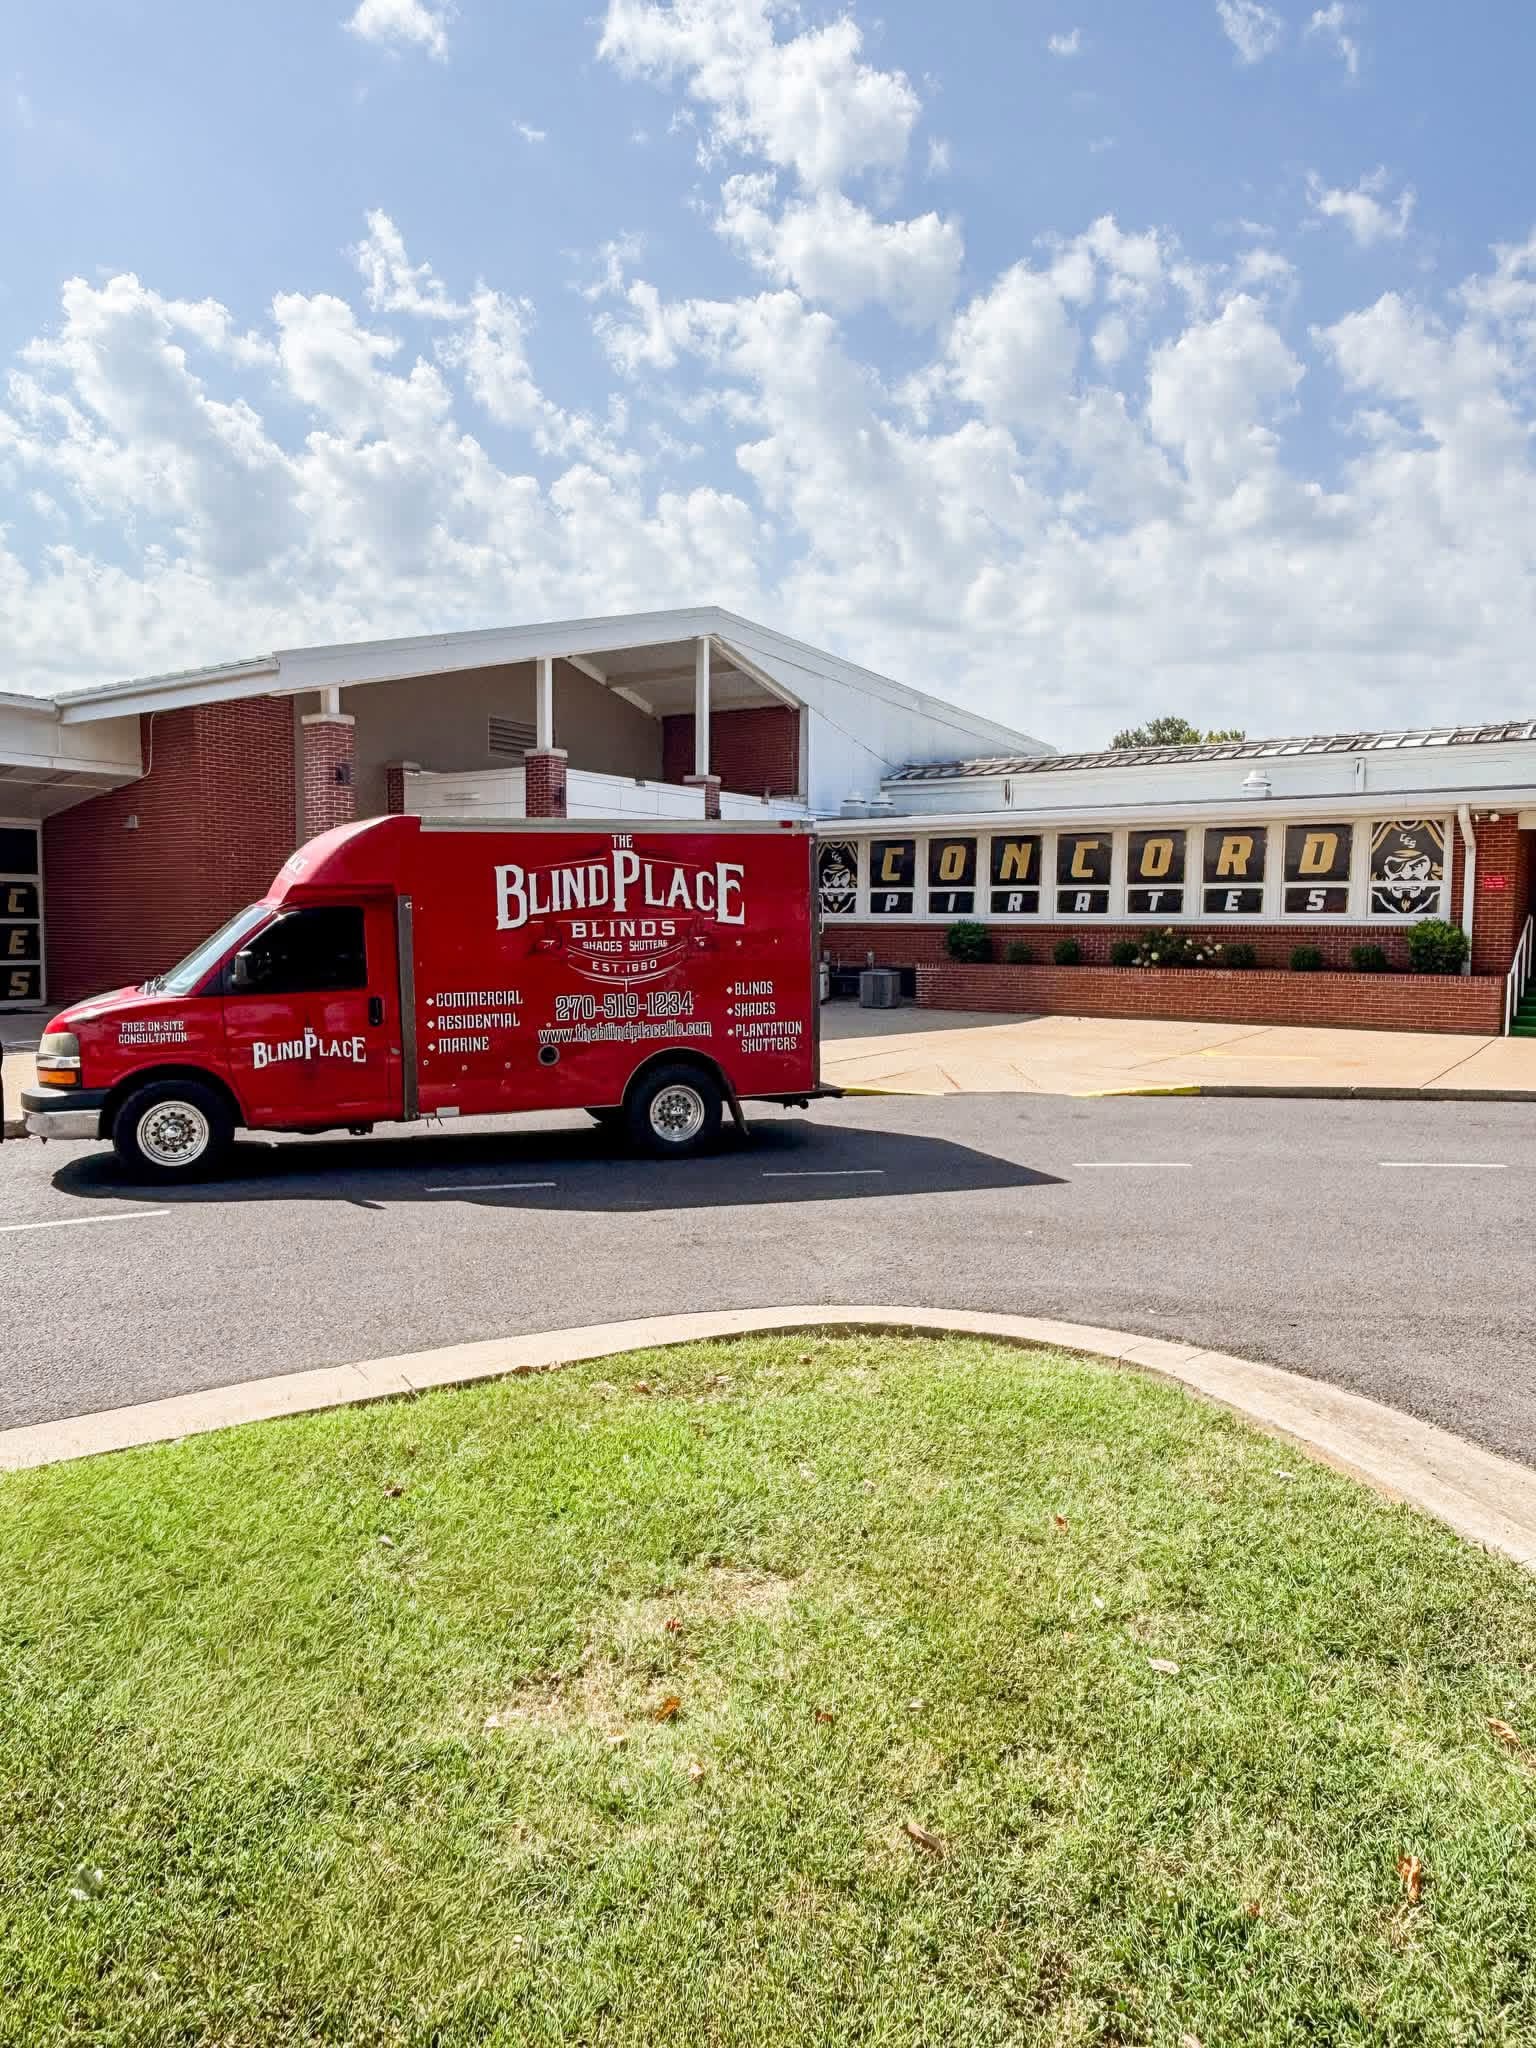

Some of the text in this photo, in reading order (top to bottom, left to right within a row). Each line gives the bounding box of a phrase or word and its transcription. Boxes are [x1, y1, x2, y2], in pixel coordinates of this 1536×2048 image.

[612, 834, 633, 849] THE
[881, 832, 1339, 881] CONCORD
[884, 890, 1327, 913] PIRATES
[571, 920, 676, 938] BLINDS
[582, 940, 622, 952] SHADES
[735, 981, 773, 996] BLINDS
[436, 990, 523, 1008] COMMERCIAL
[555, 990, 694, 1021] 270-519-1234
[735, 1001, 776, 1017] SHADES
[122, 1020, 184, 1032] FREE ON-SITE
[438, 1012, 521, 1031] RESIDENTIAL
[735, 1021, 802, 1038] PLANTATION
[119, 1032, 187, 1044] CONSULTATION
[439, 1036, 489, 1054] MARINE
[741, 1036, 797, 1053] SHUTTERS
